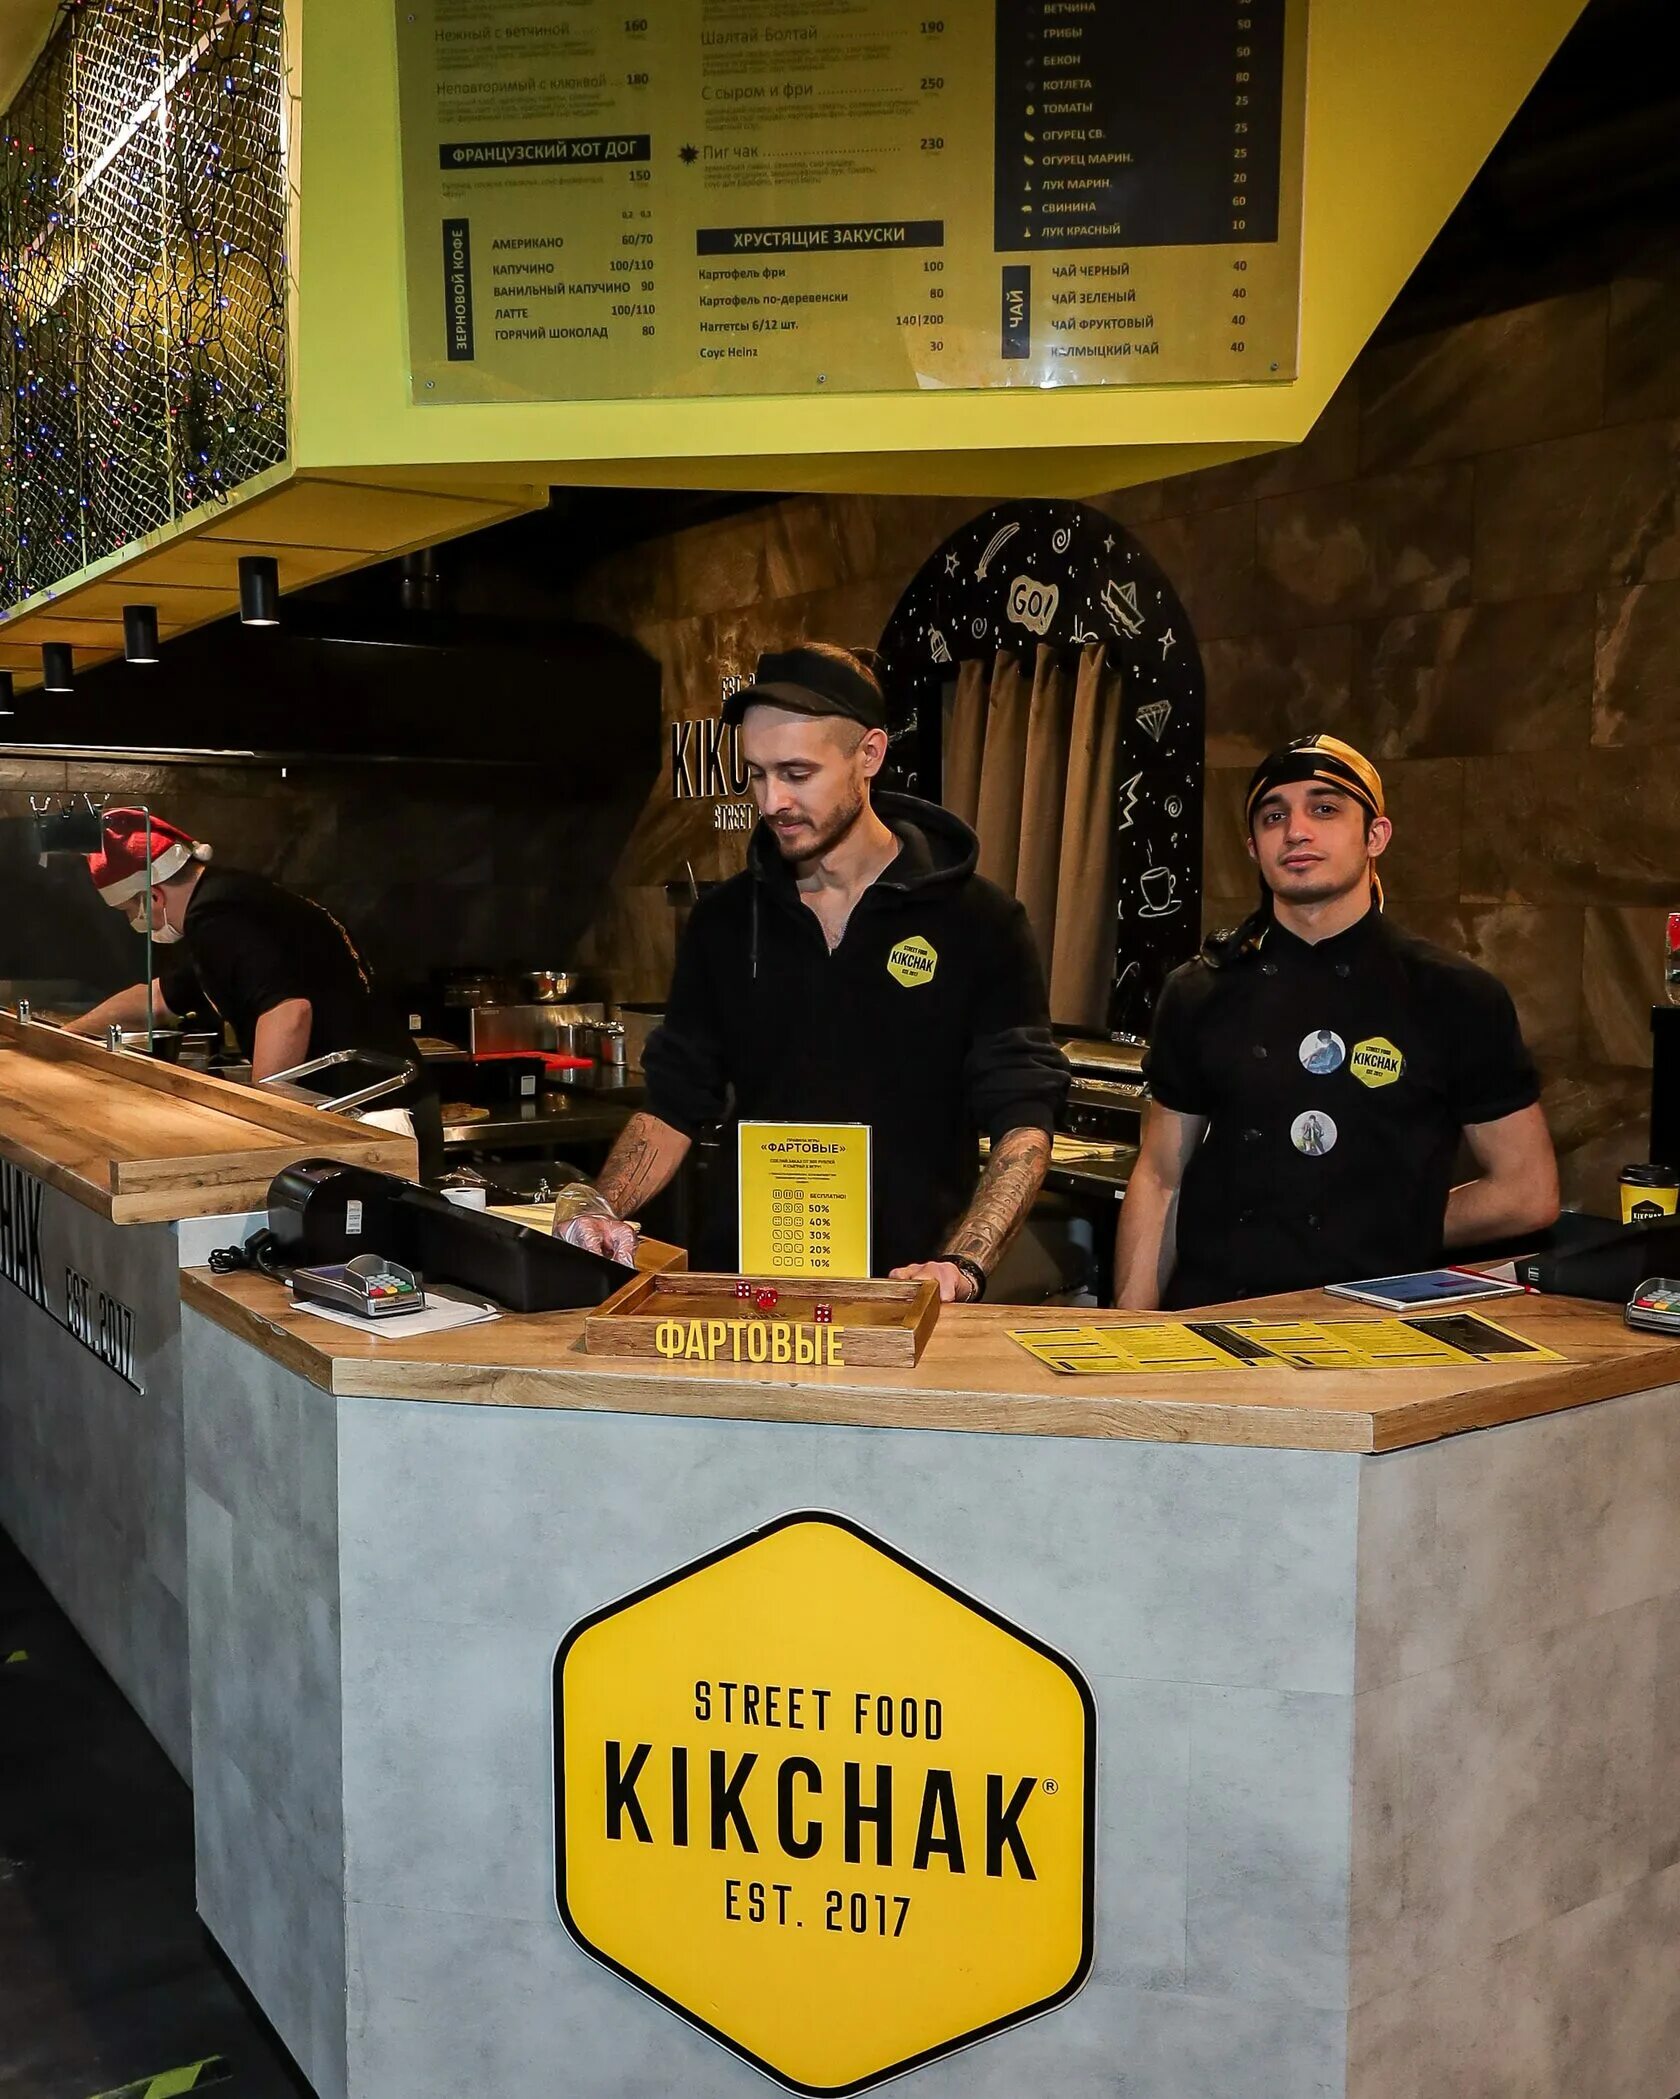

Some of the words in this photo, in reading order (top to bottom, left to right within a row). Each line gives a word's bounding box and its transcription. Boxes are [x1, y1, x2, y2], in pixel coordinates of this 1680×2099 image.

[1043, 2, 1096, 14] ВЕТЧИНА
[624, 19, 648, 32] 160
[920, 20, 945, 33] 190
[1237, 19, 1251, 29] 50
[434, 27, 491, 42] Нежный
[495, 30, 501, 39] с
[505, 24, 570, 39] ветчиной
[701, 29, 758, 46] Шалтай
[765, 25, 818, 41] Болтай
[1043, 28, 1082, 39] ГРИБЫ
[1236, 47, 1250, 57] 50
[1043, 55, 1081, 66] БЕКОН
[626, 73, 649, 85] 180
[1235, 72, 1249, 82] 80
[437, 79, 536, 97] Неповторимый
[540, 81, 546, 90] с
[550, 76, 606, 91] клюквой
[920, 78, 944, 90] 250
[1043, 79, 1092, 91] КОТЛЕТА
[715, 86, 765, 101] сыром
[770, 87, 779, 97] и
[783, 82, 813, 99] фри
[1235, 96, 1248, 106] 25
[1043, 103, 1093, 114] ТОМАТЫ
[1234, 123, 1248, 133] 25
[1042, 129, 1086, 142] ОГУРЕЦ
[1088, 129, 1106, 140] СВ.
[920, 138, 944, 150] 230
[452, 140, 567, 163] ФРАНЦУЗСКИЙ
[571, 141, 602, 158] ХОТ
[604, 140, 637, 158] ДОГ
[703, 145, 728, 160] Пиг
[733, 146, 758, 158] чак
[1234, 148, 1247, 158] 25
[1042, 155, 1085, 167] ОГУРЕЦ
[1088, 153, 1134, 165] МАРИН.
[628, 170, 651, 181] 150
[1233, 173, 1247, 183] 20
[1042, 180, 1065, 191] ЛУК
[1067, 178, 1113, 190] МАРИН.
[1232, 196, 1246, 206] 60
[1042, 202, 1096, 214] СВИНИНА
[1042, 226, 1064, 238] ЛУК
[1067, 223, 1121, 237] КРАСНЫЙ
[1232, 220, 1245, 230] 10
[492, 237, 564, 250] АМЕРИКАНО
[622, 234, 653, 247] 60/70
[733, 229, 829, 248] ХРУСТЯЩИЕ
[833, 228, 905, 244] ЗАКУСКИ
[452, 229, 464, 268] КОФЕ
[493, 263, 554, 276] КАПУЧИНО
[610, 260, 654, 273] 100/110
[923, 261, 944, 272] 100
[1052, 265, 1077, 278] ЧАЙ
[1080, 263, 1130, 276] ЧЕРНЫЙ
[1233, 261, 1247, 271] 40
[699, 268, 760, 282] Картофель
[762, 268, 786, 281] фри
[493, 283, 565, 297] ВАНИЛЬНЫЙ
[568, 283, 630, 295] КАПУЧИНО
[641, 281, 654, 291] 90
[929, 288, 944, 299] 80
[1052, 291, 1076, 304] ЧАЙ
[1079, 290, 1136, 304] ЗЕЛЕНЫЙ
[1232, 288, 1246, 299] 40
[699, 294, 760, 308] Картофель
[763, 293, 848, 306] по-деревенски
[451, 273, 468, 350] ЗЕРНОВОЙ
[495, 309, 528, 320] ЛАТТЕ
[611, 304, 655, 317] 100/110
[1006, 290, 1023, 328] ЧАЙ
[700, 322, 749, 333] Наггетсы
[752, 319, 777, 332] 6/12
[780, 319, 799, 331] шт.
[1052, 318, 1076, 331] ЧАЙ
[1079, 315, 1154, 330] ФРУКТОВЫЙ
[1231, 315, 1245, 326] 40
[495, 326, 546, 340] ГОРЯЧИЙ
[549, 326, 608, 340] ШОКОЛАД
[642, 325, 655, 336] 80
[700, 347, 725, 359] Соус
[728, 346, 758, 357] Heinz
[930, 341, 944, 351] 30
[1134, 342, 1159, 355] ЧАЙ
[1231, 342, 1244, 353] 40
[1014, 584, 1053, 625] GO!
[713, 803, 753, 830] STREET
[891, 951, 934, 972] KIKCHAK
[1354, 1052, 1398, 1072] KIKCHAK
[761, 1143, 846, 1153] «ФАРТОВЫЕ»
[808, 1204, 830, 1213] 50%
[809, 1218, 831, 1227] 40%
[809, 1231, 831, 1240] 30%
[809, 1245, 831, 1254] 20%
[810, 1259, 830, 1268] 10%
[65, 1265, 100, 1351] EST.
[100, 1290, 135, 1379] 2017
[655, 1318, 845, 1367] ФАРТОВЫЕ
[694, 1680, 831, 1731] STREET
[855, 1693, 943, 1741] FOOD
[725, 1880, 803, 1928] EST.
[825, 1890, 911, 1938] 2017
